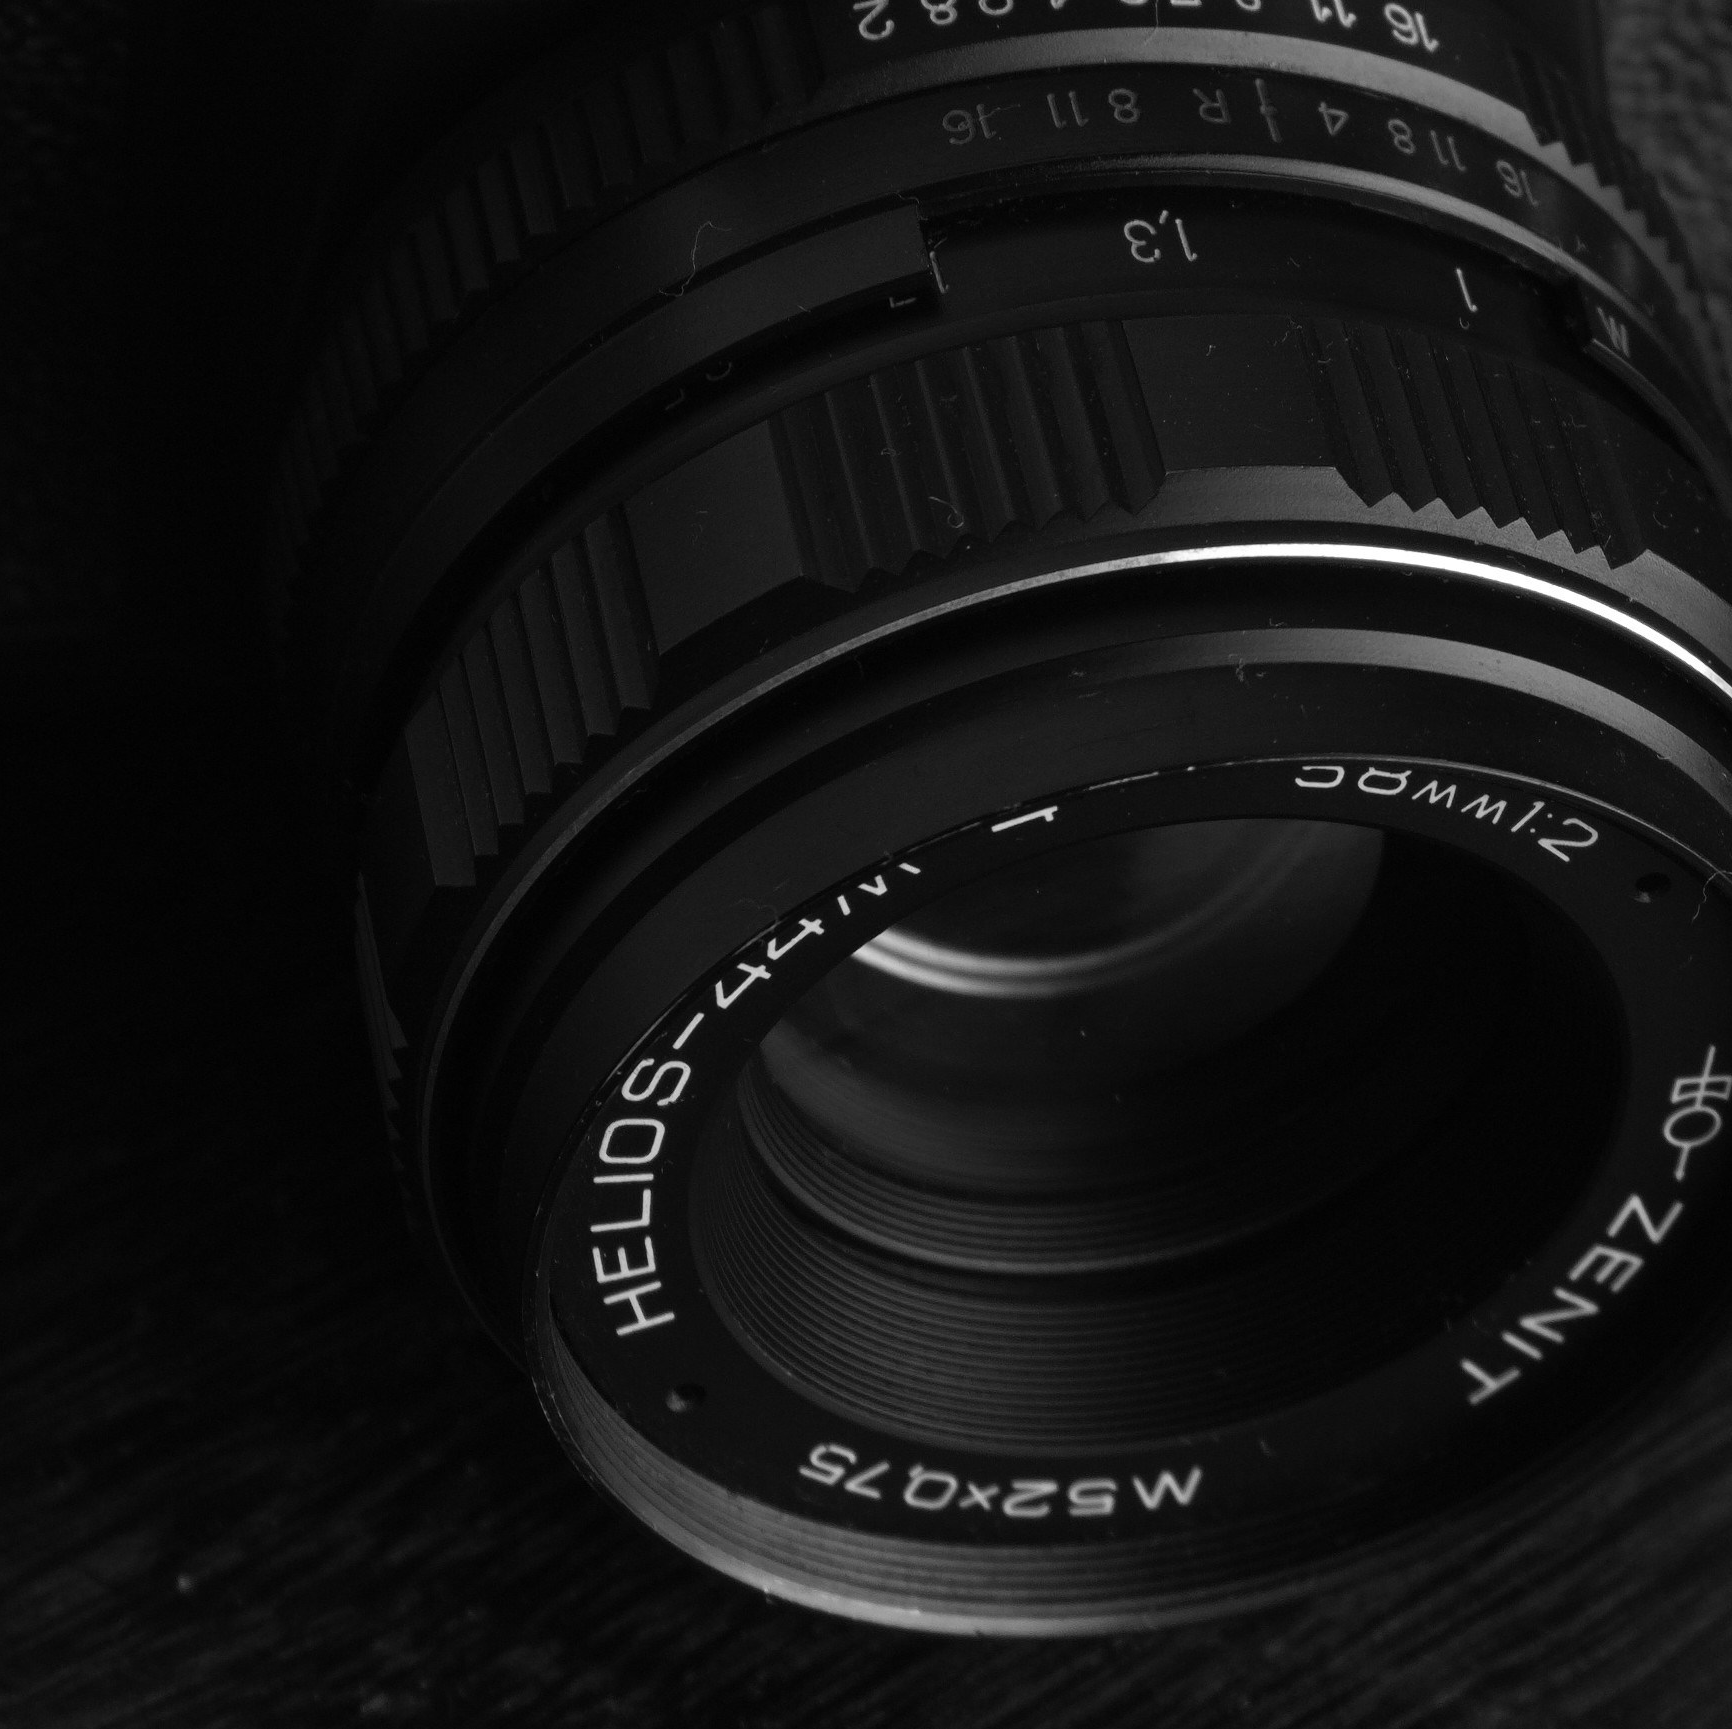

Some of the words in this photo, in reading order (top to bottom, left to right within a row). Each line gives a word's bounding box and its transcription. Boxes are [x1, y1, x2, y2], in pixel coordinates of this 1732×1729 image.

[1382, 1, 1440, 53] 16
[940, 102, 996, 147] 16
[1045, 89, 1090, 129] 11
[1106, 86, 1141, 125] 8
[1191, 87, 1230, 125] R
[1316, 100, 1350, 137] 4
[1386, 117, 1417, 156] 8
[1428, 128, 1468, 173] 11
[1495, 159, 1538, 207] 16
[1122, 208, 1199, 265] 1,3
[1460, 1193, 1684, 1405] ZENIT
